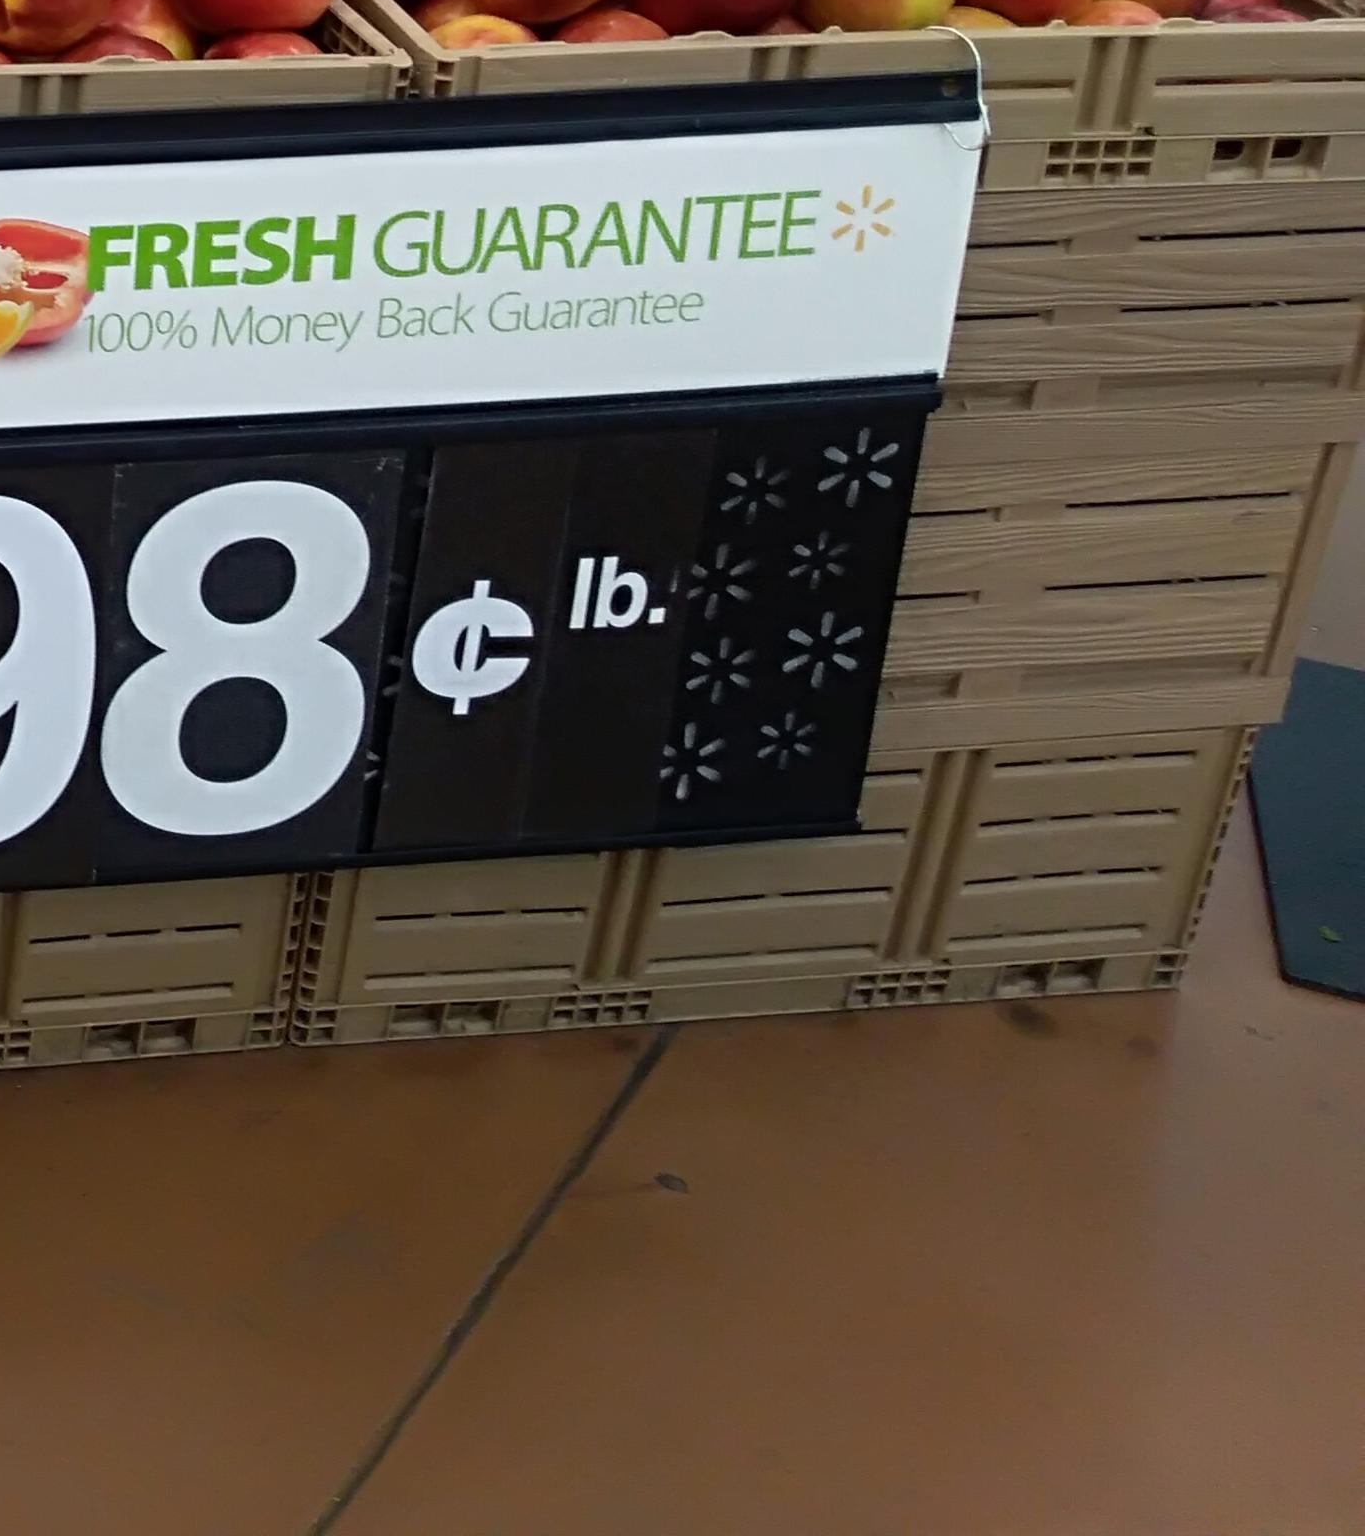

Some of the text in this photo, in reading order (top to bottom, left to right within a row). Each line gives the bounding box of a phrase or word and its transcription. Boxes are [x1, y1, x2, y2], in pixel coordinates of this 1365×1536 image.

[86, 190, 820, 294] FRESH GUARANTEE
[84, 289, 705, 353] 100% Money Back Guarantee
[568, 556, 667, 632] lb.
